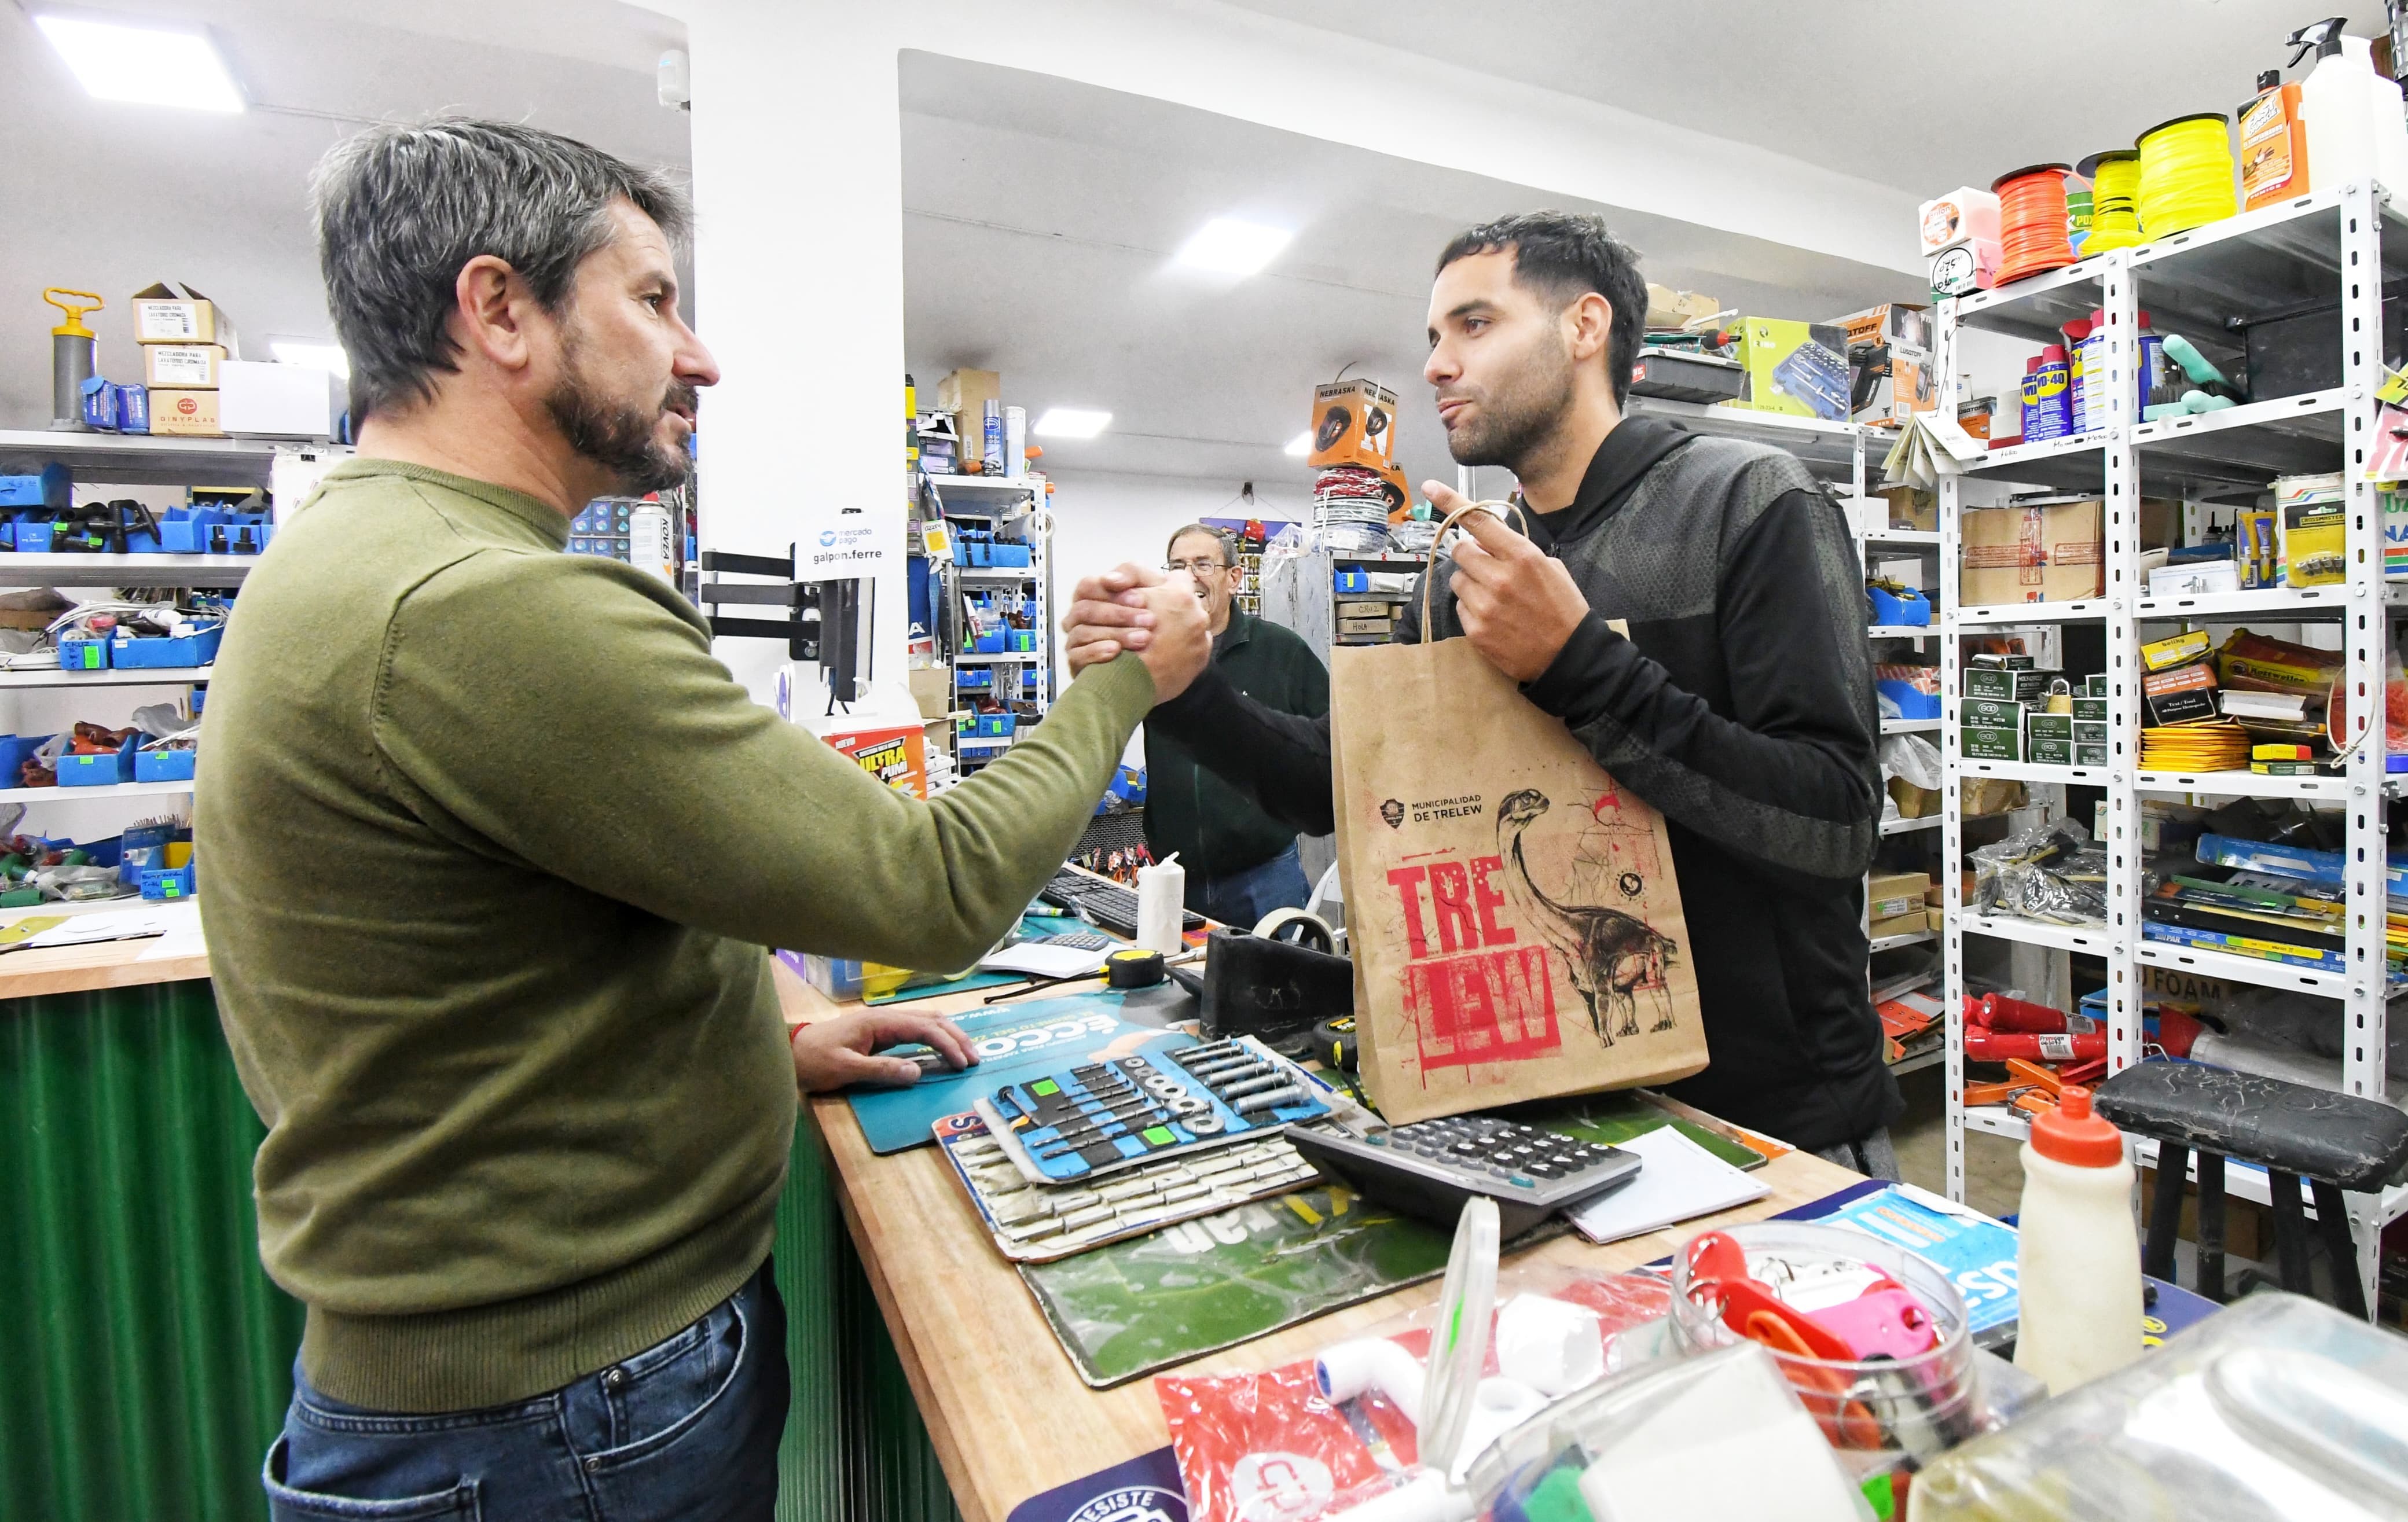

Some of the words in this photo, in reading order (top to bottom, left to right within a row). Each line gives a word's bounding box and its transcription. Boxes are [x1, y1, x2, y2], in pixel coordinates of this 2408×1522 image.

[2250, 183, 2282, 200] PUMICE
[1319, 385, 1356, 398] NEBRASKA
[839, 528, 872, 536] mercado
[813, 549, 882, 564] galpon.ferre
[1381, 552, 1387, 562] 2
[860, 746, 907, 772] ULTRA
[1412, 795, 1482, 810] MUNICIPALIDAD
[1414, 811, 1430, 822] DE
[1433, 804, 1482, 819] TRELEW
[1387, 854, 1516, 959] TRE
[2153, 968, 2221, 1002] FOAM
[1412, 948, 1546, 1058] LEW
